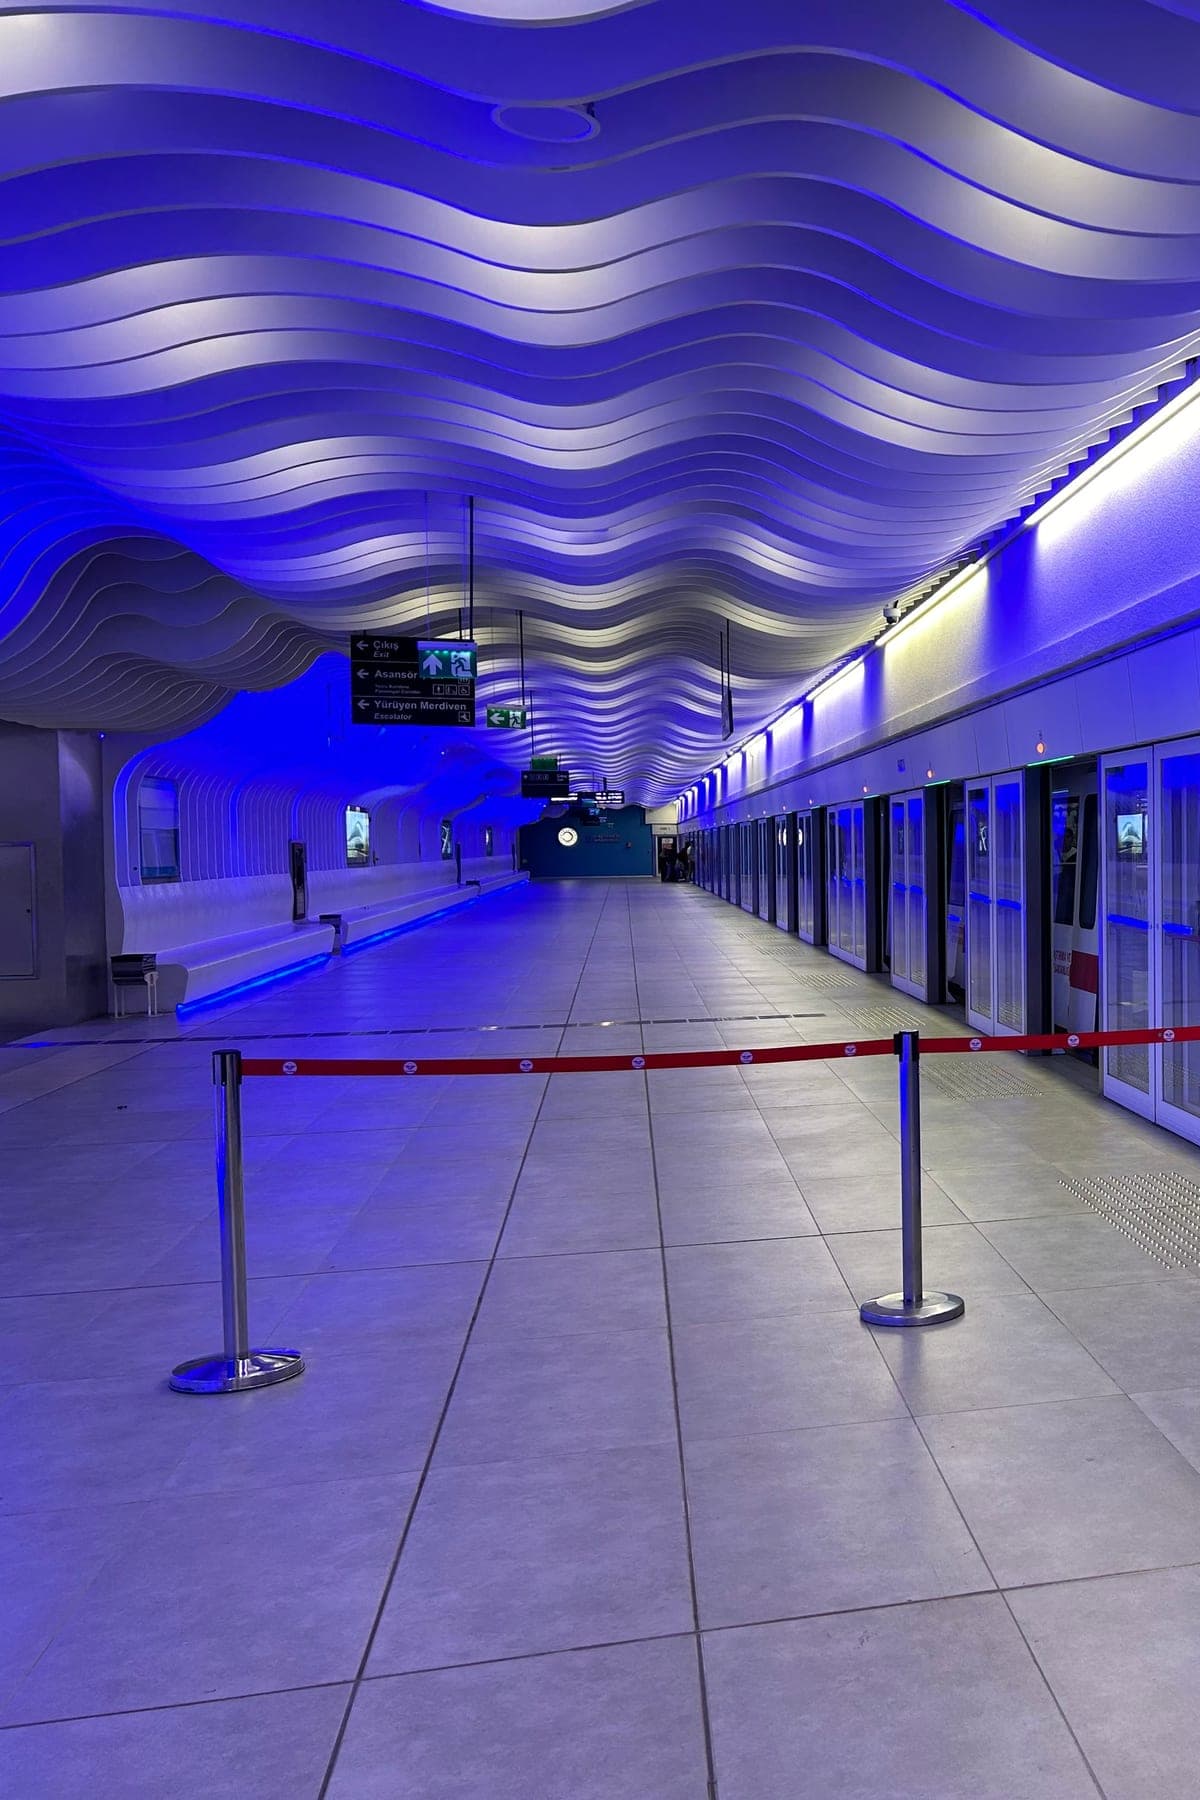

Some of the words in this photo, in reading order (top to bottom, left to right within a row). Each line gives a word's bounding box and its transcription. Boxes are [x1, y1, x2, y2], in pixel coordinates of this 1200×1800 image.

[373, 640, 399, 651] Çıkış
[374, 669, 418, 679] Asansör
[374, 700, 417, 711] Yürüyen
[420, 702, 467, 711] Merdiven
[374, 712, 412, 721] Escalator
